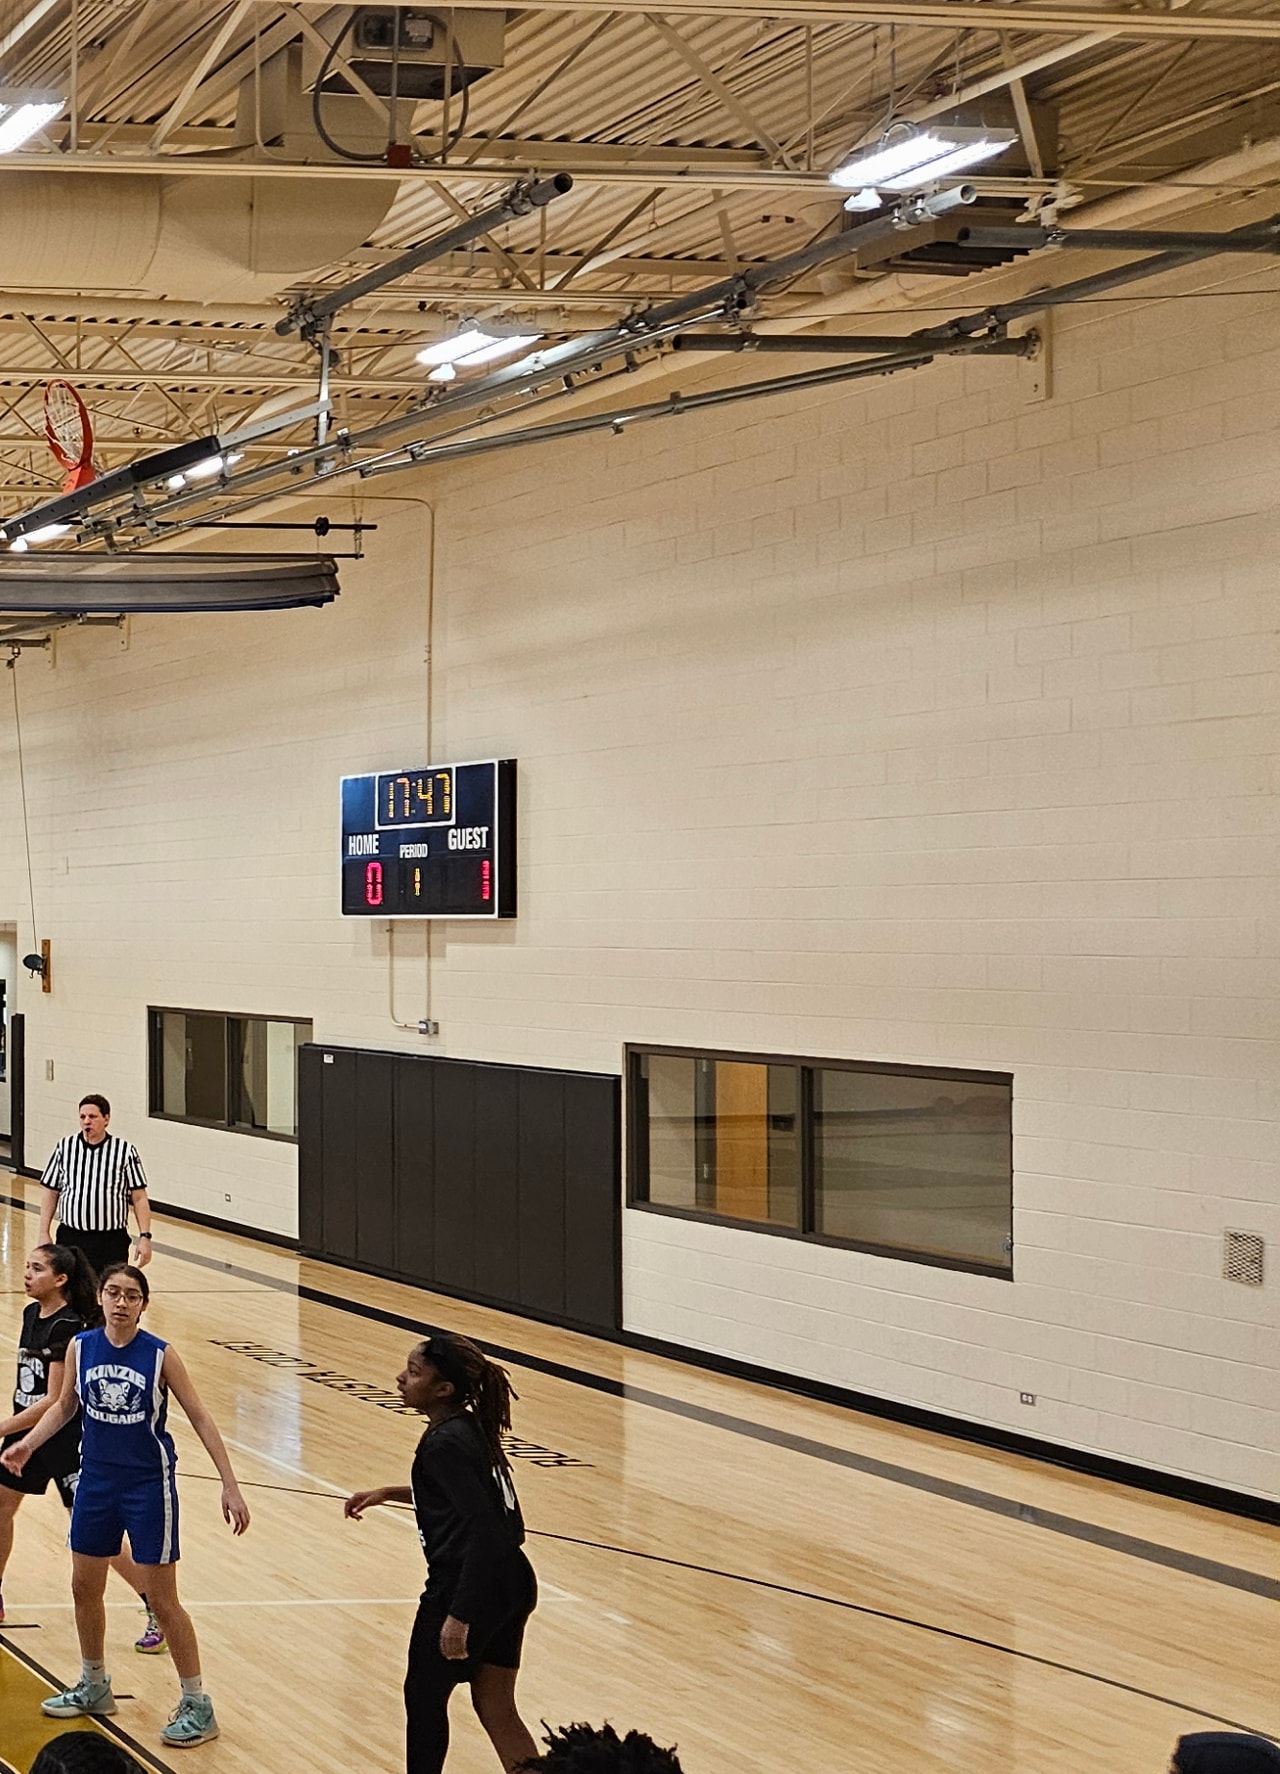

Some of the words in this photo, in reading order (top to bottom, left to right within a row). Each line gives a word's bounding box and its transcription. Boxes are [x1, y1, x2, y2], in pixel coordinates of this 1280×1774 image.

[388, 773, 451, 818] 17:47
[348, 834, 379, 856] HOME
[399, 844, 428, 858] PERIOD
[448, 826, 489, 850] GUEST
[366, 861, 383, 905] 0
[414, 868, 421, 897] 1
[481, 860, 490, 900] 1
[206, 1340, 317, 1367] COURT
[85, 1364, 146, 1391] KINZIE
[86, 1404, 145, 1425] COUGARS
